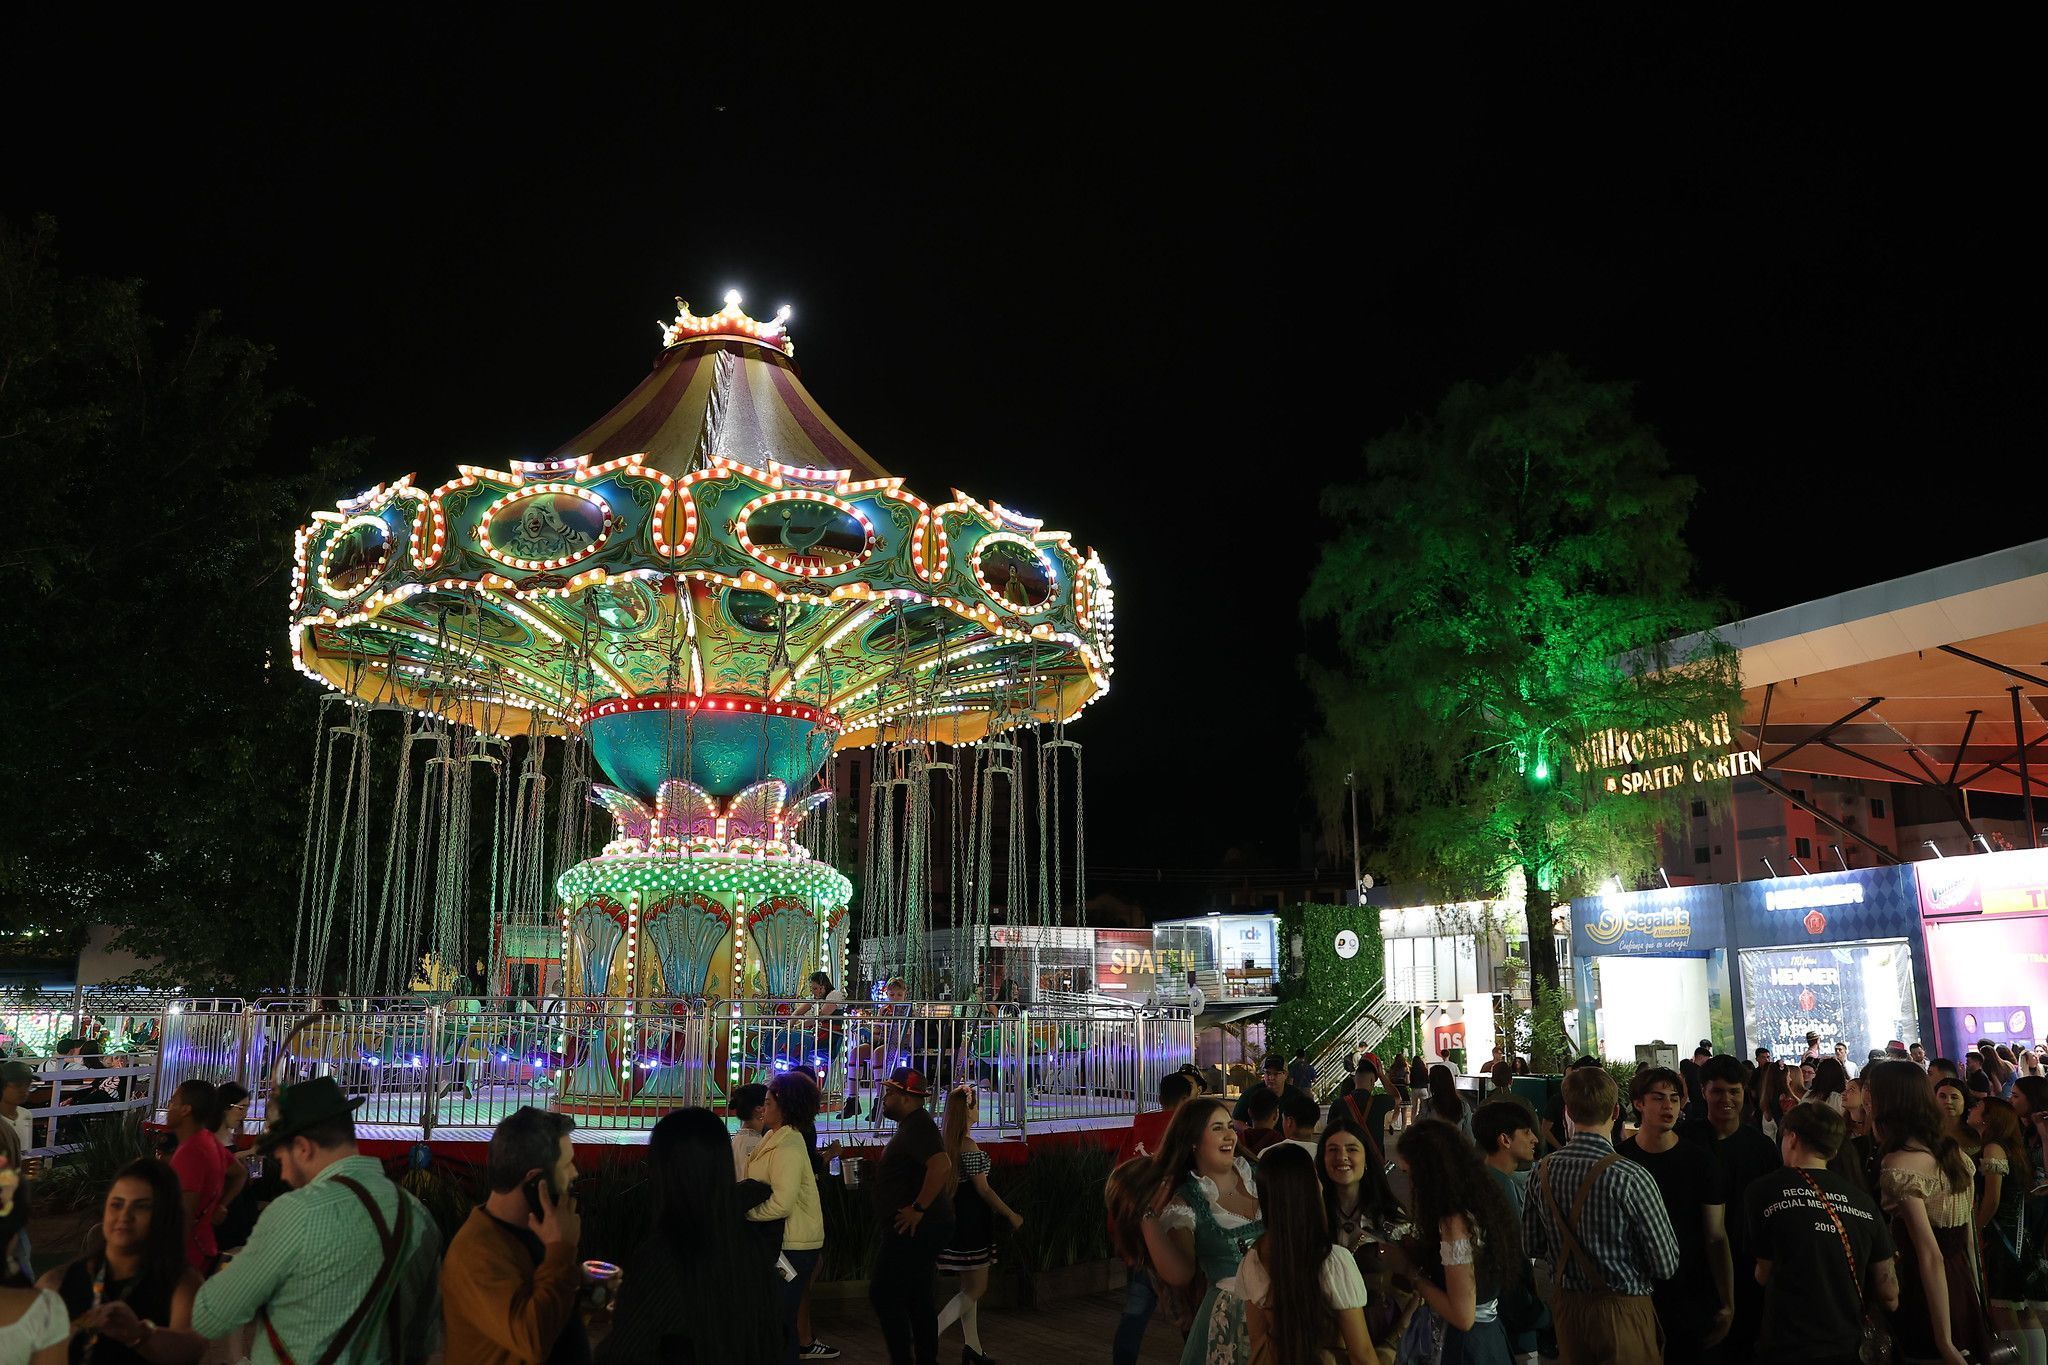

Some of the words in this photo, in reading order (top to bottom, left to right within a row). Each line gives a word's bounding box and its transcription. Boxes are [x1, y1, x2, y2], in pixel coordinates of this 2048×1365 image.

[1621, 763, 1684, 795] SPATEN
[1692, 749, 1762, 783] GARTEN
[1783, 1187, 1818, 1198] RECAY
[1825, 1192, 1848, 1203] MOB
[1763, 1199, 1805, 1218] OFFICIAL
[1814, 1222, 1836, 1233] 2019
